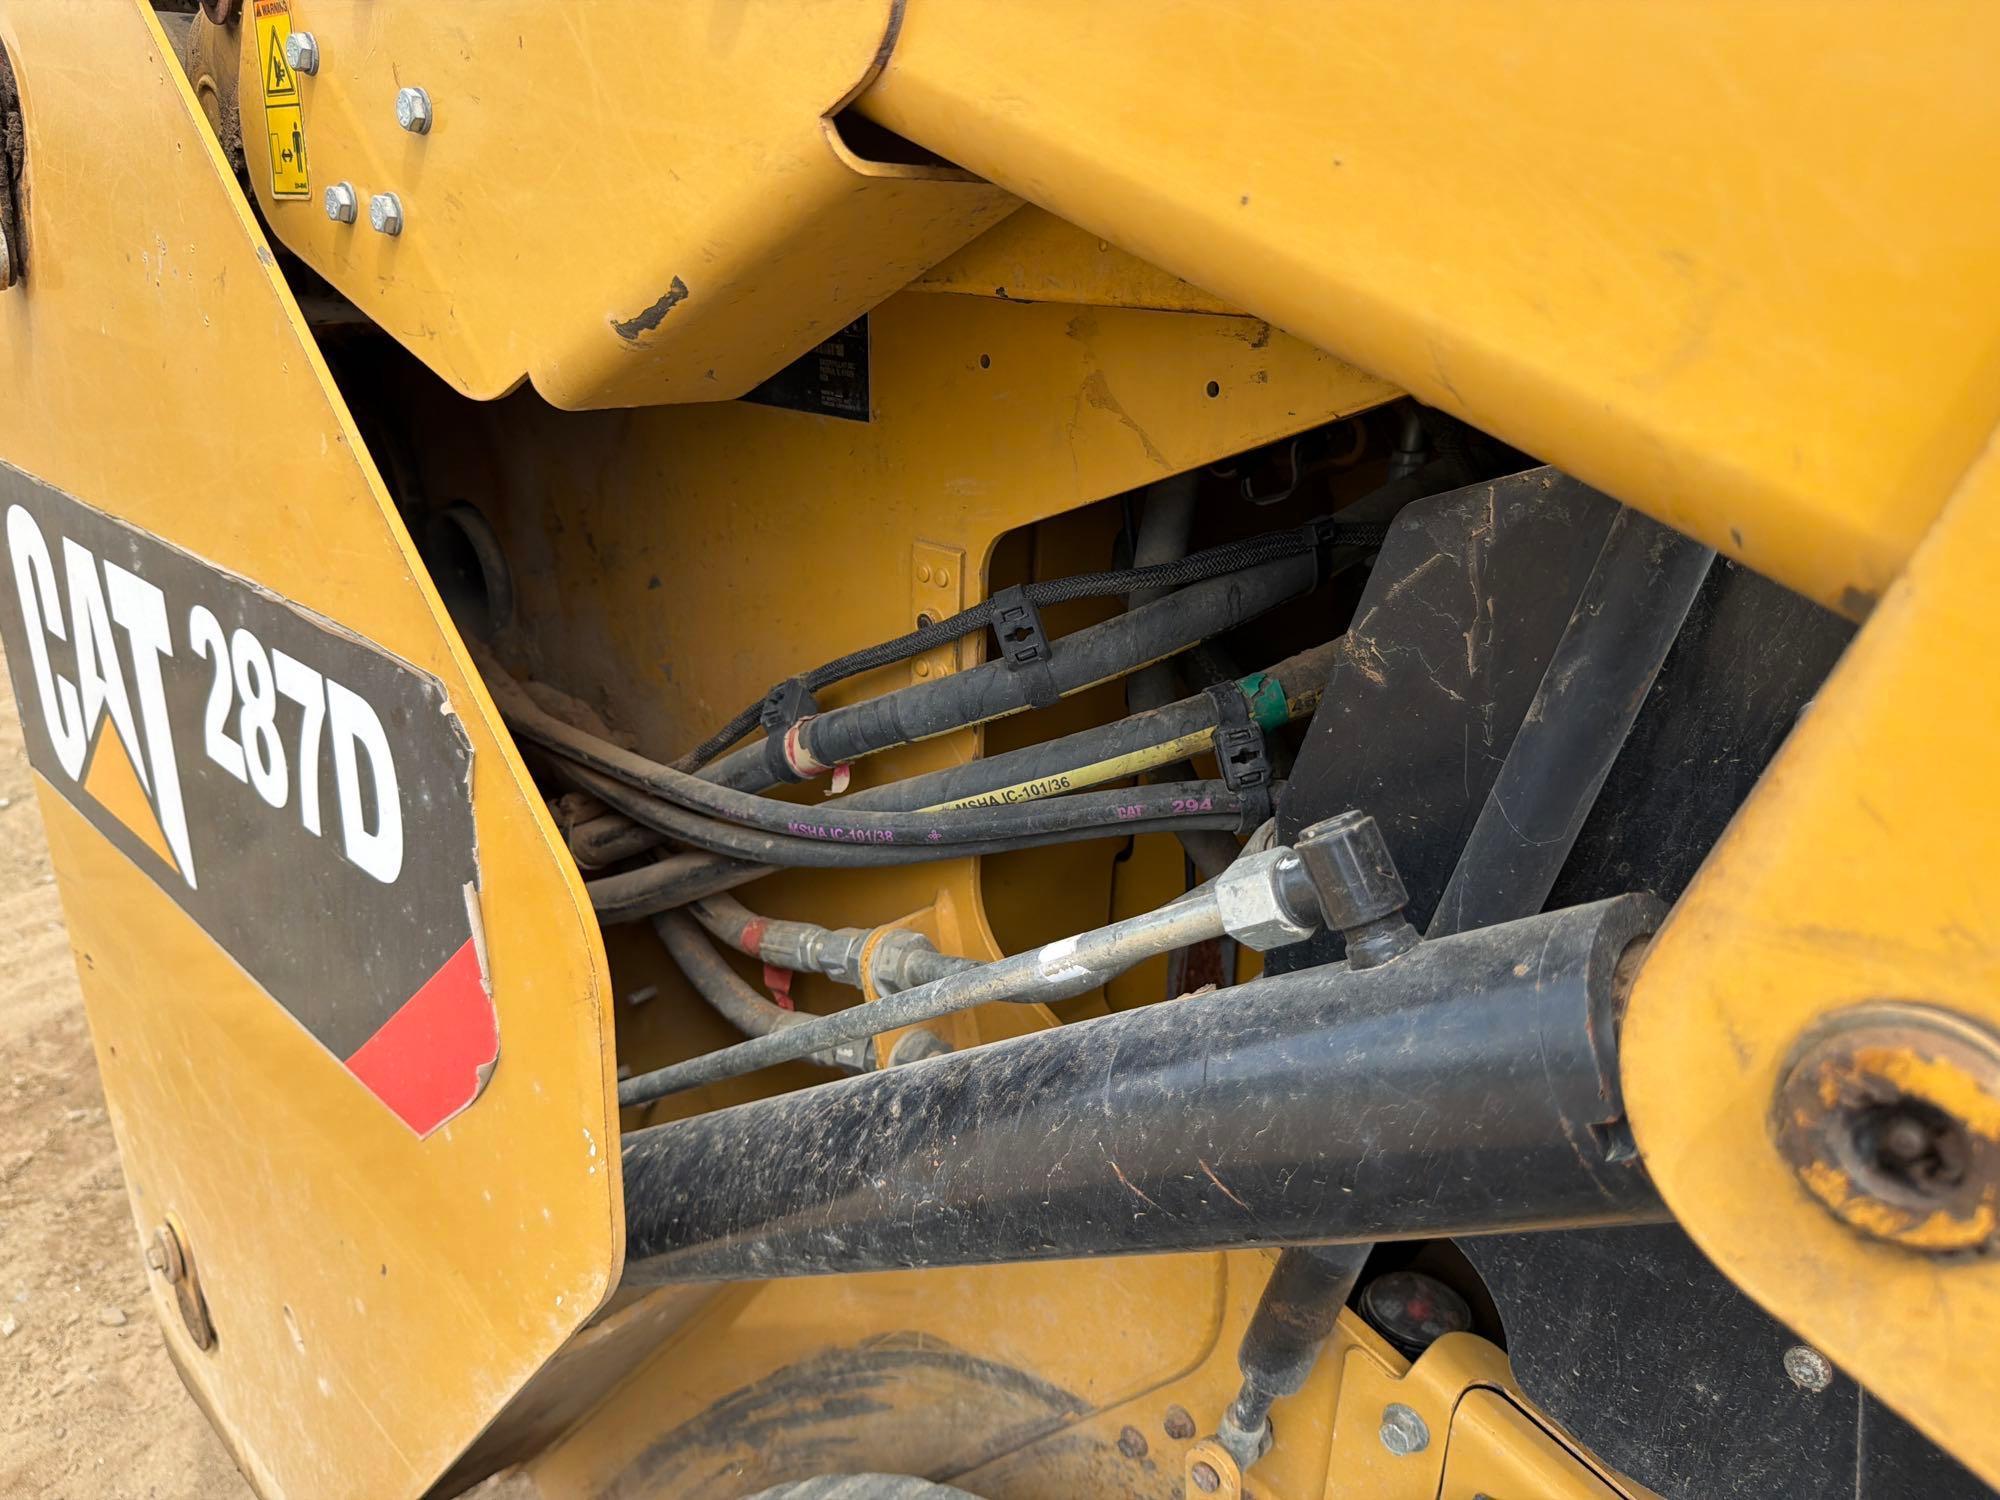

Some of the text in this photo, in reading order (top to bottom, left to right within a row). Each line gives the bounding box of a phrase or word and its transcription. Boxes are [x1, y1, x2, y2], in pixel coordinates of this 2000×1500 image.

[7, 504, 403, 889] CAT 287D
[1003, 776, 1070, 804] IC-101/36
[788, 798, 1213, 843] MSHA IC-101/38 CAT 294
